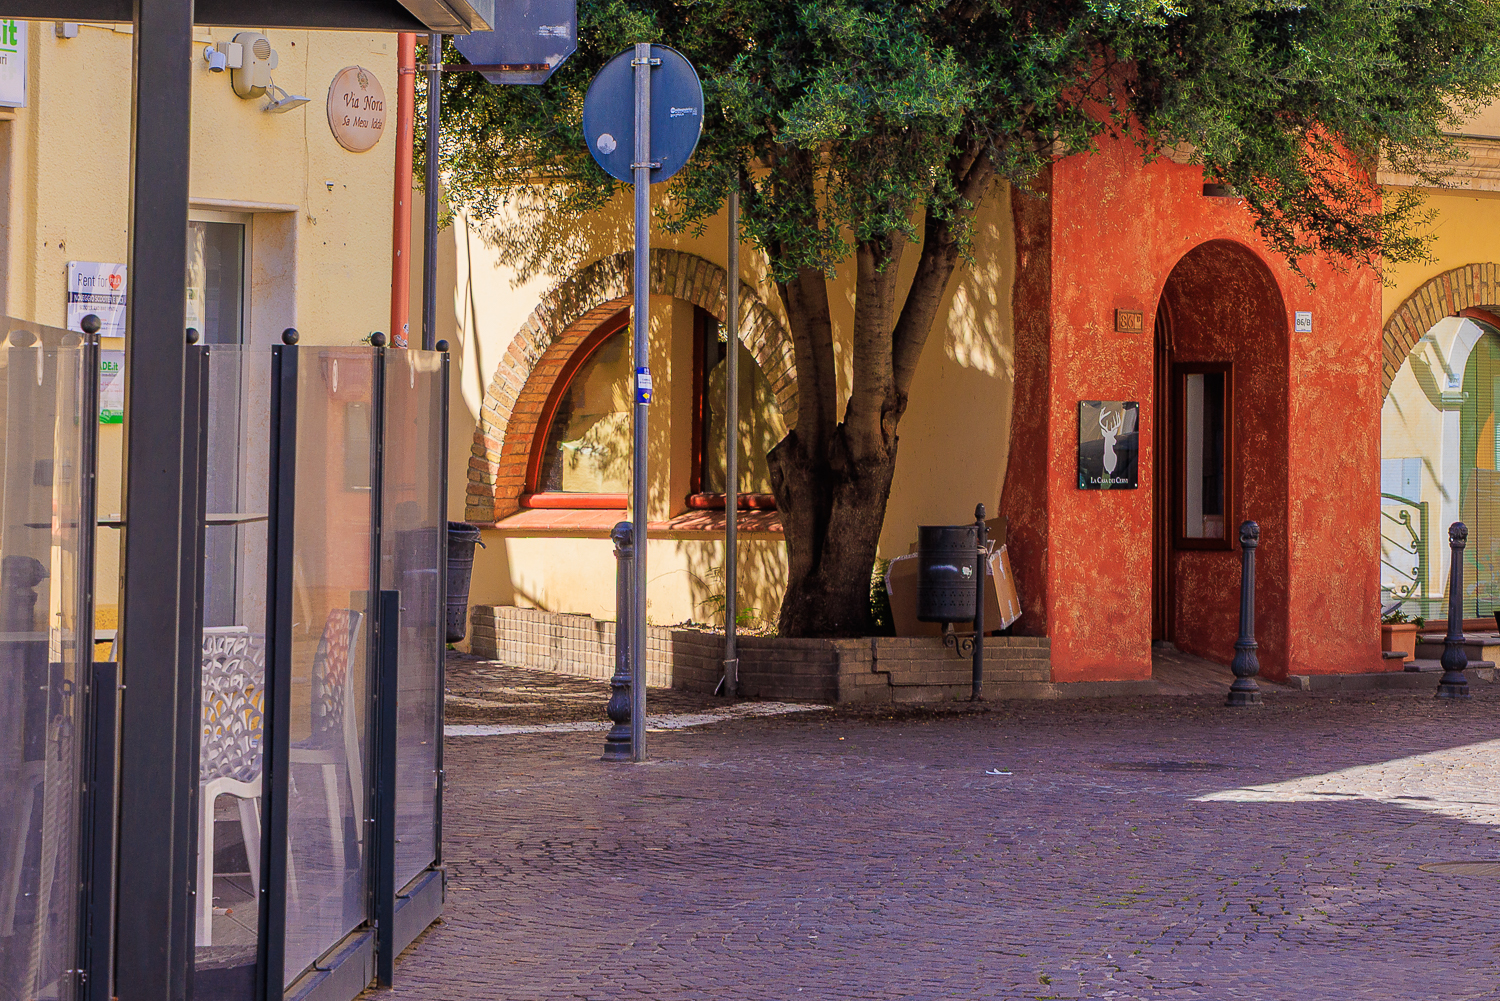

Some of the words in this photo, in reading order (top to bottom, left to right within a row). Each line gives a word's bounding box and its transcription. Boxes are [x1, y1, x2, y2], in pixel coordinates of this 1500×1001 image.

[343, 91, 359, 108] Via
[363, 95, 383, 112] Nora
[77, 272, 96, 287] Rent
[98, 275, 108, 288] for
